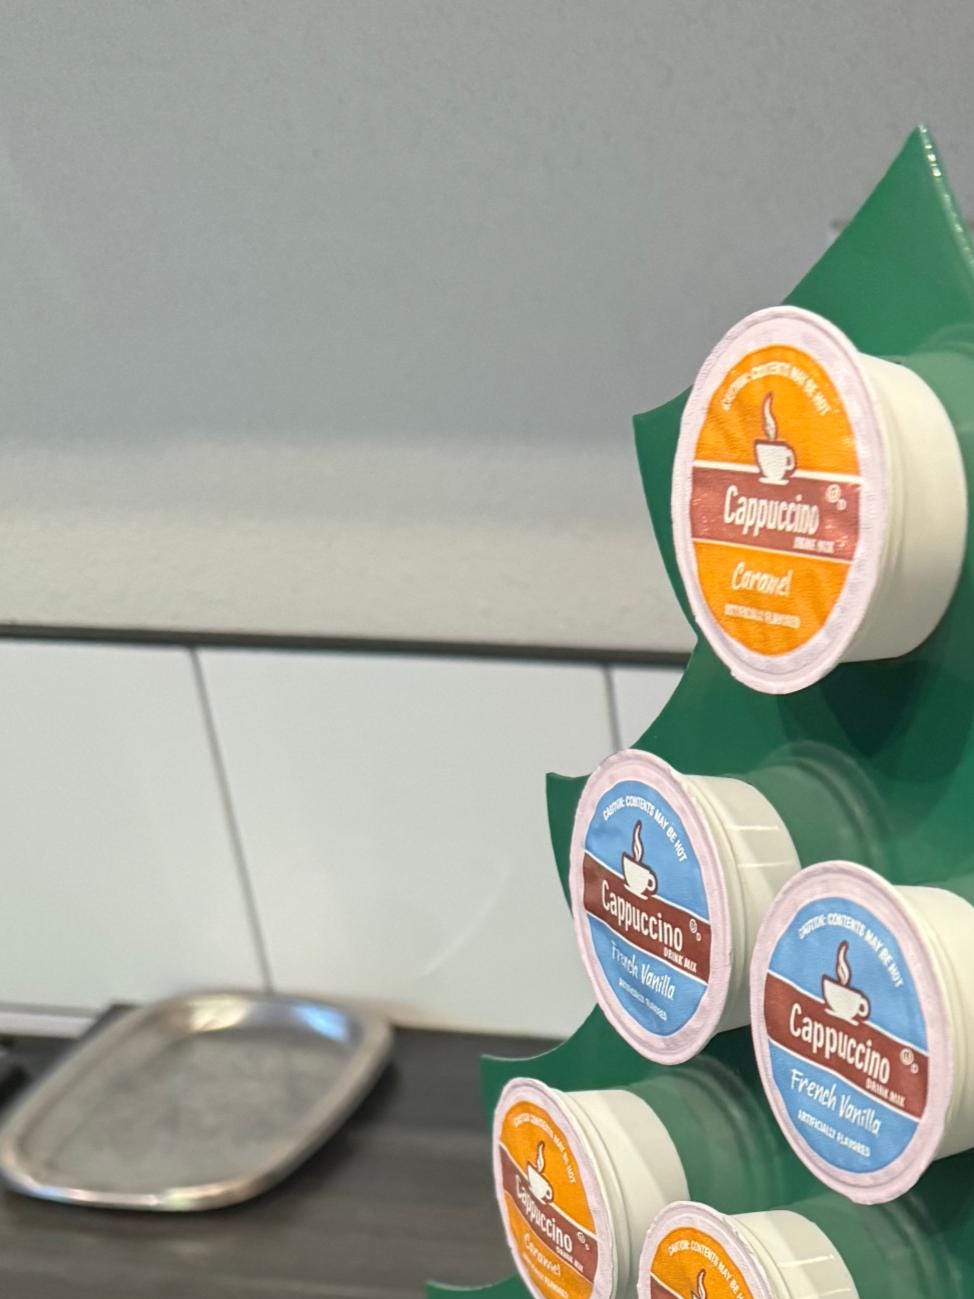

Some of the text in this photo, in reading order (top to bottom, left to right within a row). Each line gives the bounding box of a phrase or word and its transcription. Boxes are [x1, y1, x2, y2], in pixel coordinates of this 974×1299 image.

[723, 484, 820, 536] Cappuccino
[730, 562, 792, 597] Caramel
[653, 808, 669, 829] MAY
[601, 879, 684, 952] Cappuccino
[663, 946, 684, 967] DRINK
[864, 928, 882, 952] MAY
[641, 962, 676, 1000] Vanilla
[789, 1002, 891, 1085] Cappuccino
[789, 1067, 882, 1137] French Vanilla
[515, 1174, 573, 1253] Cappuccino
[717, 1261, 732, 1282] MAY
